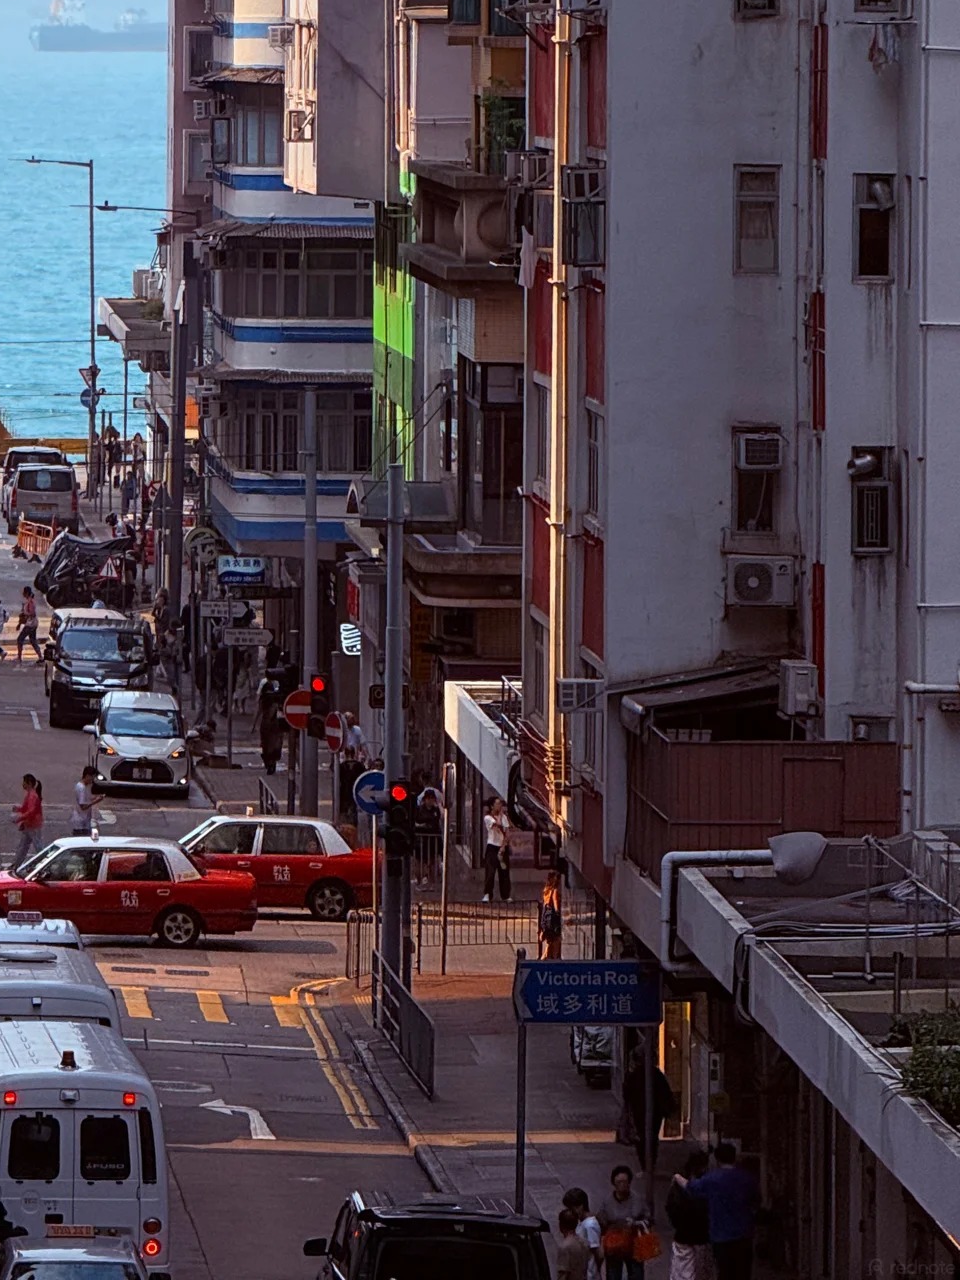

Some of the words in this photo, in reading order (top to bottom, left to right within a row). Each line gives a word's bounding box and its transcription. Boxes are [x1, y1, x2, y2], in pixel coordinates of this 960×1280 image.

[273, 864, 290, 873] 的士
[273, 872, 291, 882] TAXI
[120, 890, 138, 899] 的士
[122, 898, 139, 908] TAXI
[10, 912, 40, 920] TAXI
[536, 970, 602, 986] Victoria
[604, 971, 639, 986] Roa
[536, 993, 634, 1016] 域多利道
[52, 1226, 91, 1234] TAXI
